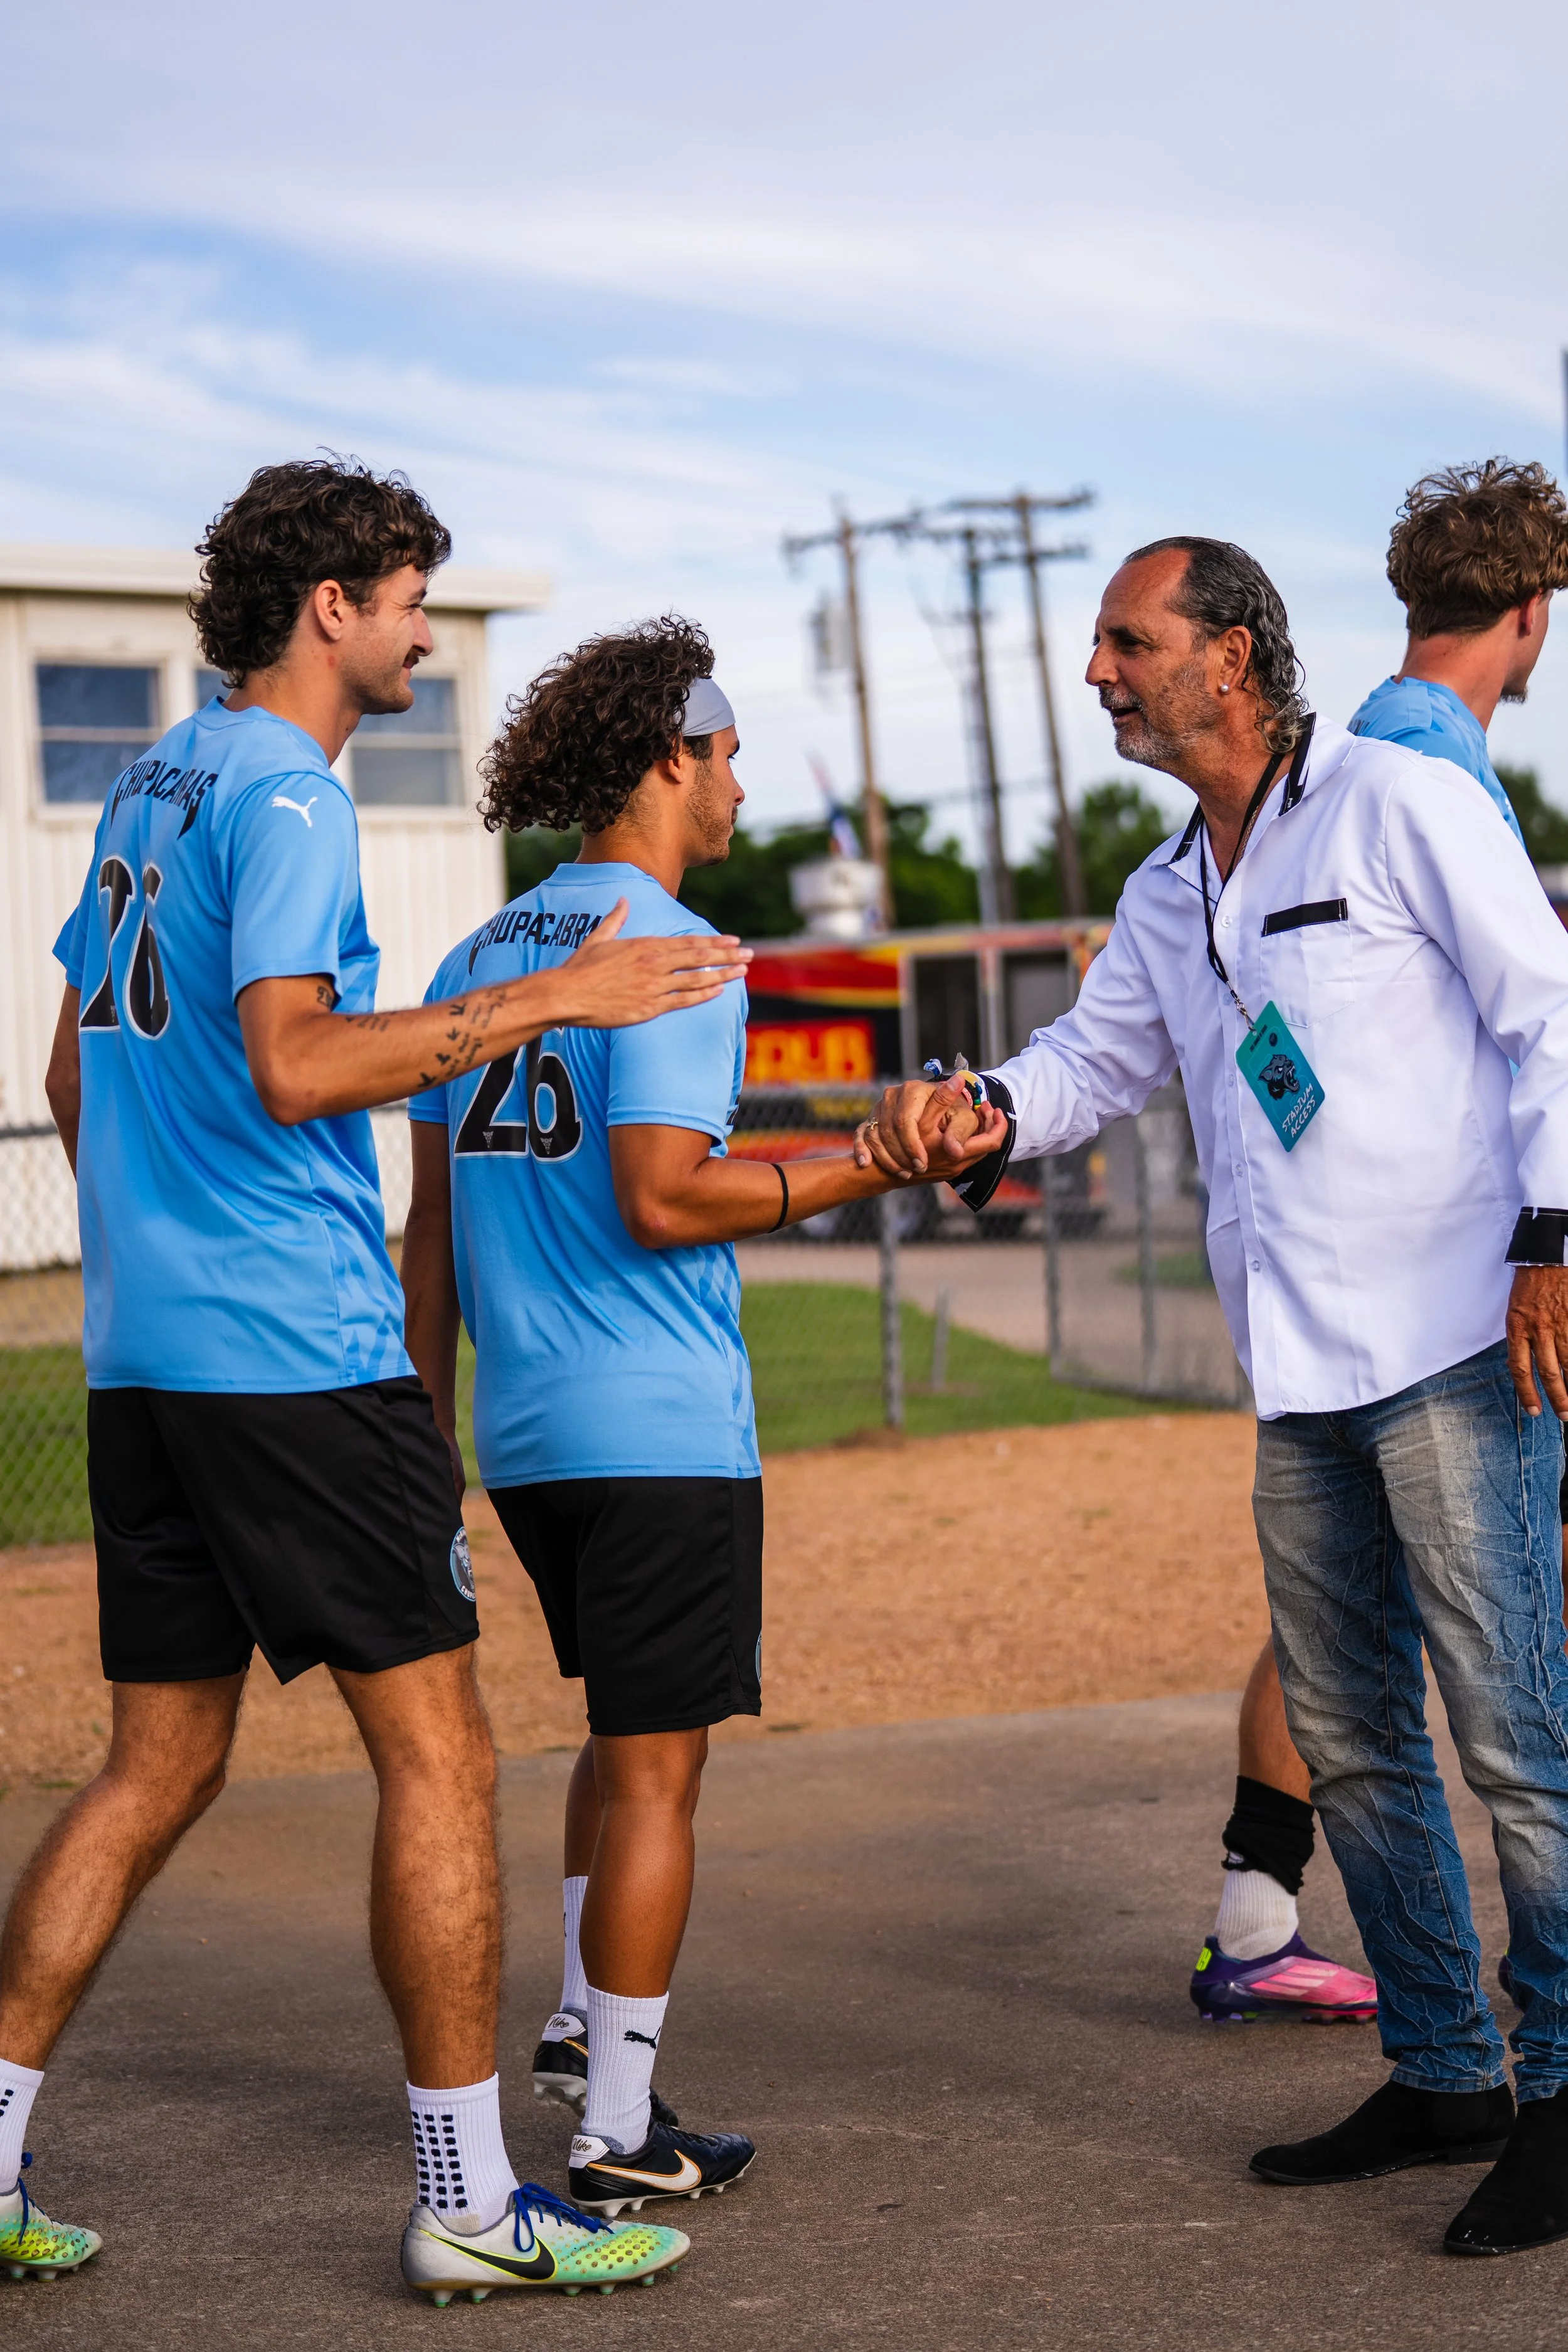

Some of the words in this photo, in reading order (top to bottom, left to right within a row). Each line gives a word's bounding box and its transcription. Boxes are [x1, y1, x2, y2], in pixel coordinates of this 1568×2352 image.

[79, 854, 171, 1041] 26
[1282, 1083, 1313, 1133] STADIUM
[1291, 1095, 1315, 1138] ACCESS
[548, 2016, 569, 2029] Nike
[572, 2137, 592, 2152] Nike
